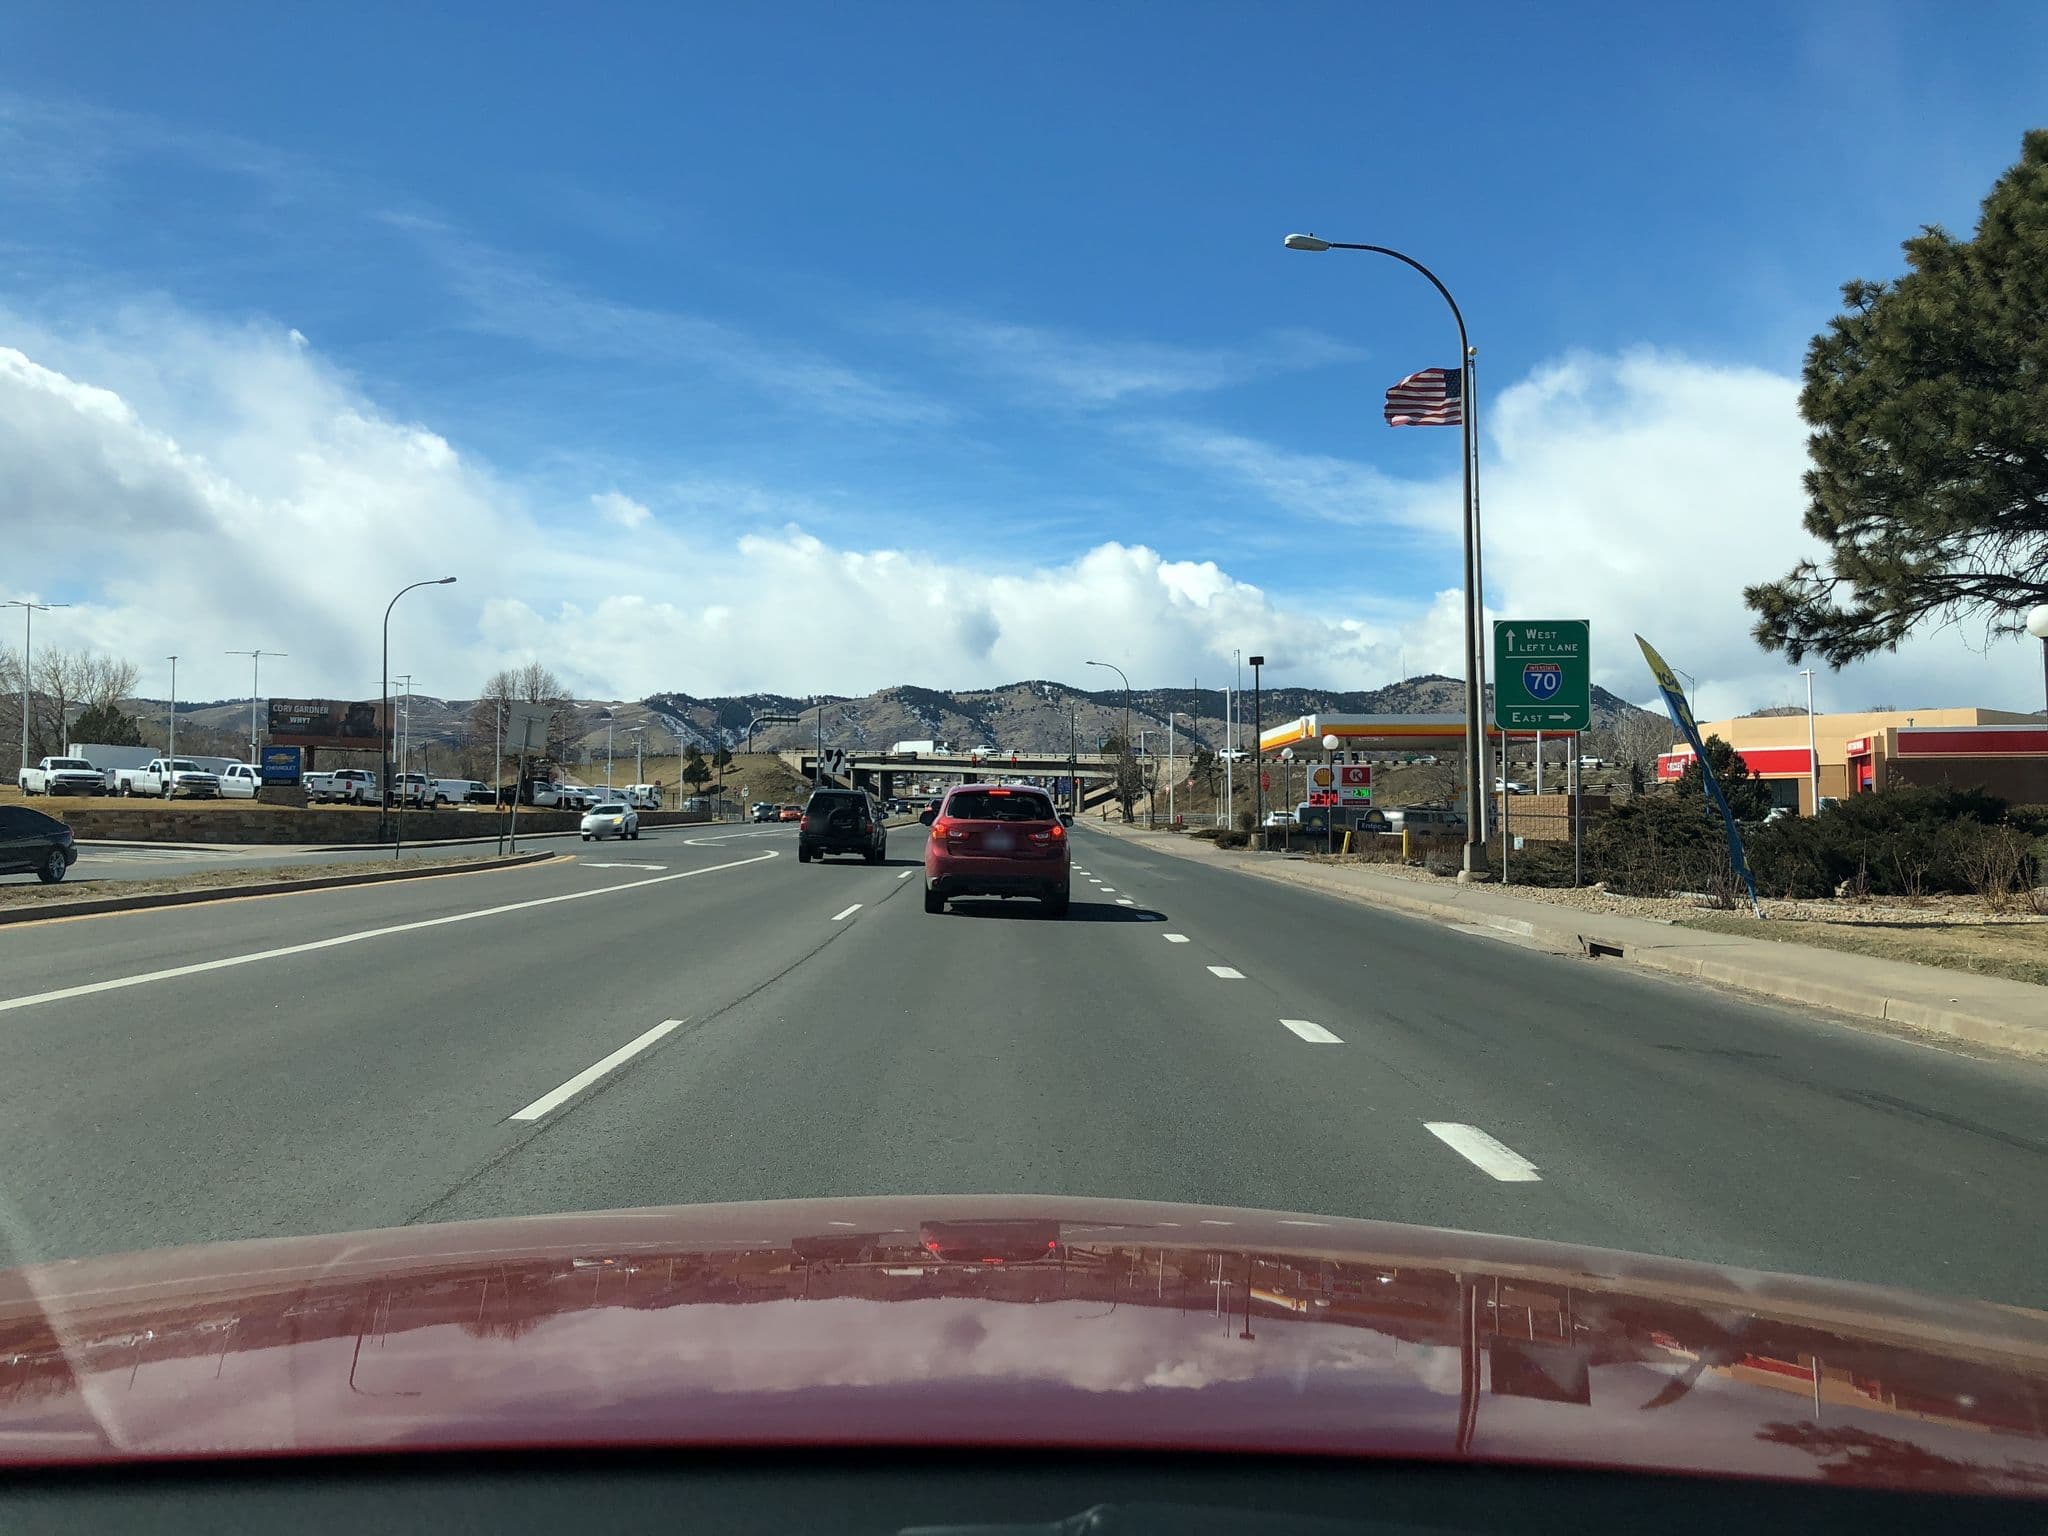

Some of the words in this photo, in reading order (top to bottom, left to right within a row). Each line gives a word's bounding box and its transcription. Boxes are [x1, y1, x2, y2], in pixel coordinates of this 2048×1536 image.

[1526, 629, 1557, 639] WEST
[1520, 644, 1545, 652] LEFT
[1549, 643, 1578, 652] LANE
[1531, 673, 1556, 690] 70
[273, 704, 293, 713] CORY
[294, 705, 329, 714] GARDNER
[1512, 712, 1542, 723] EAST
